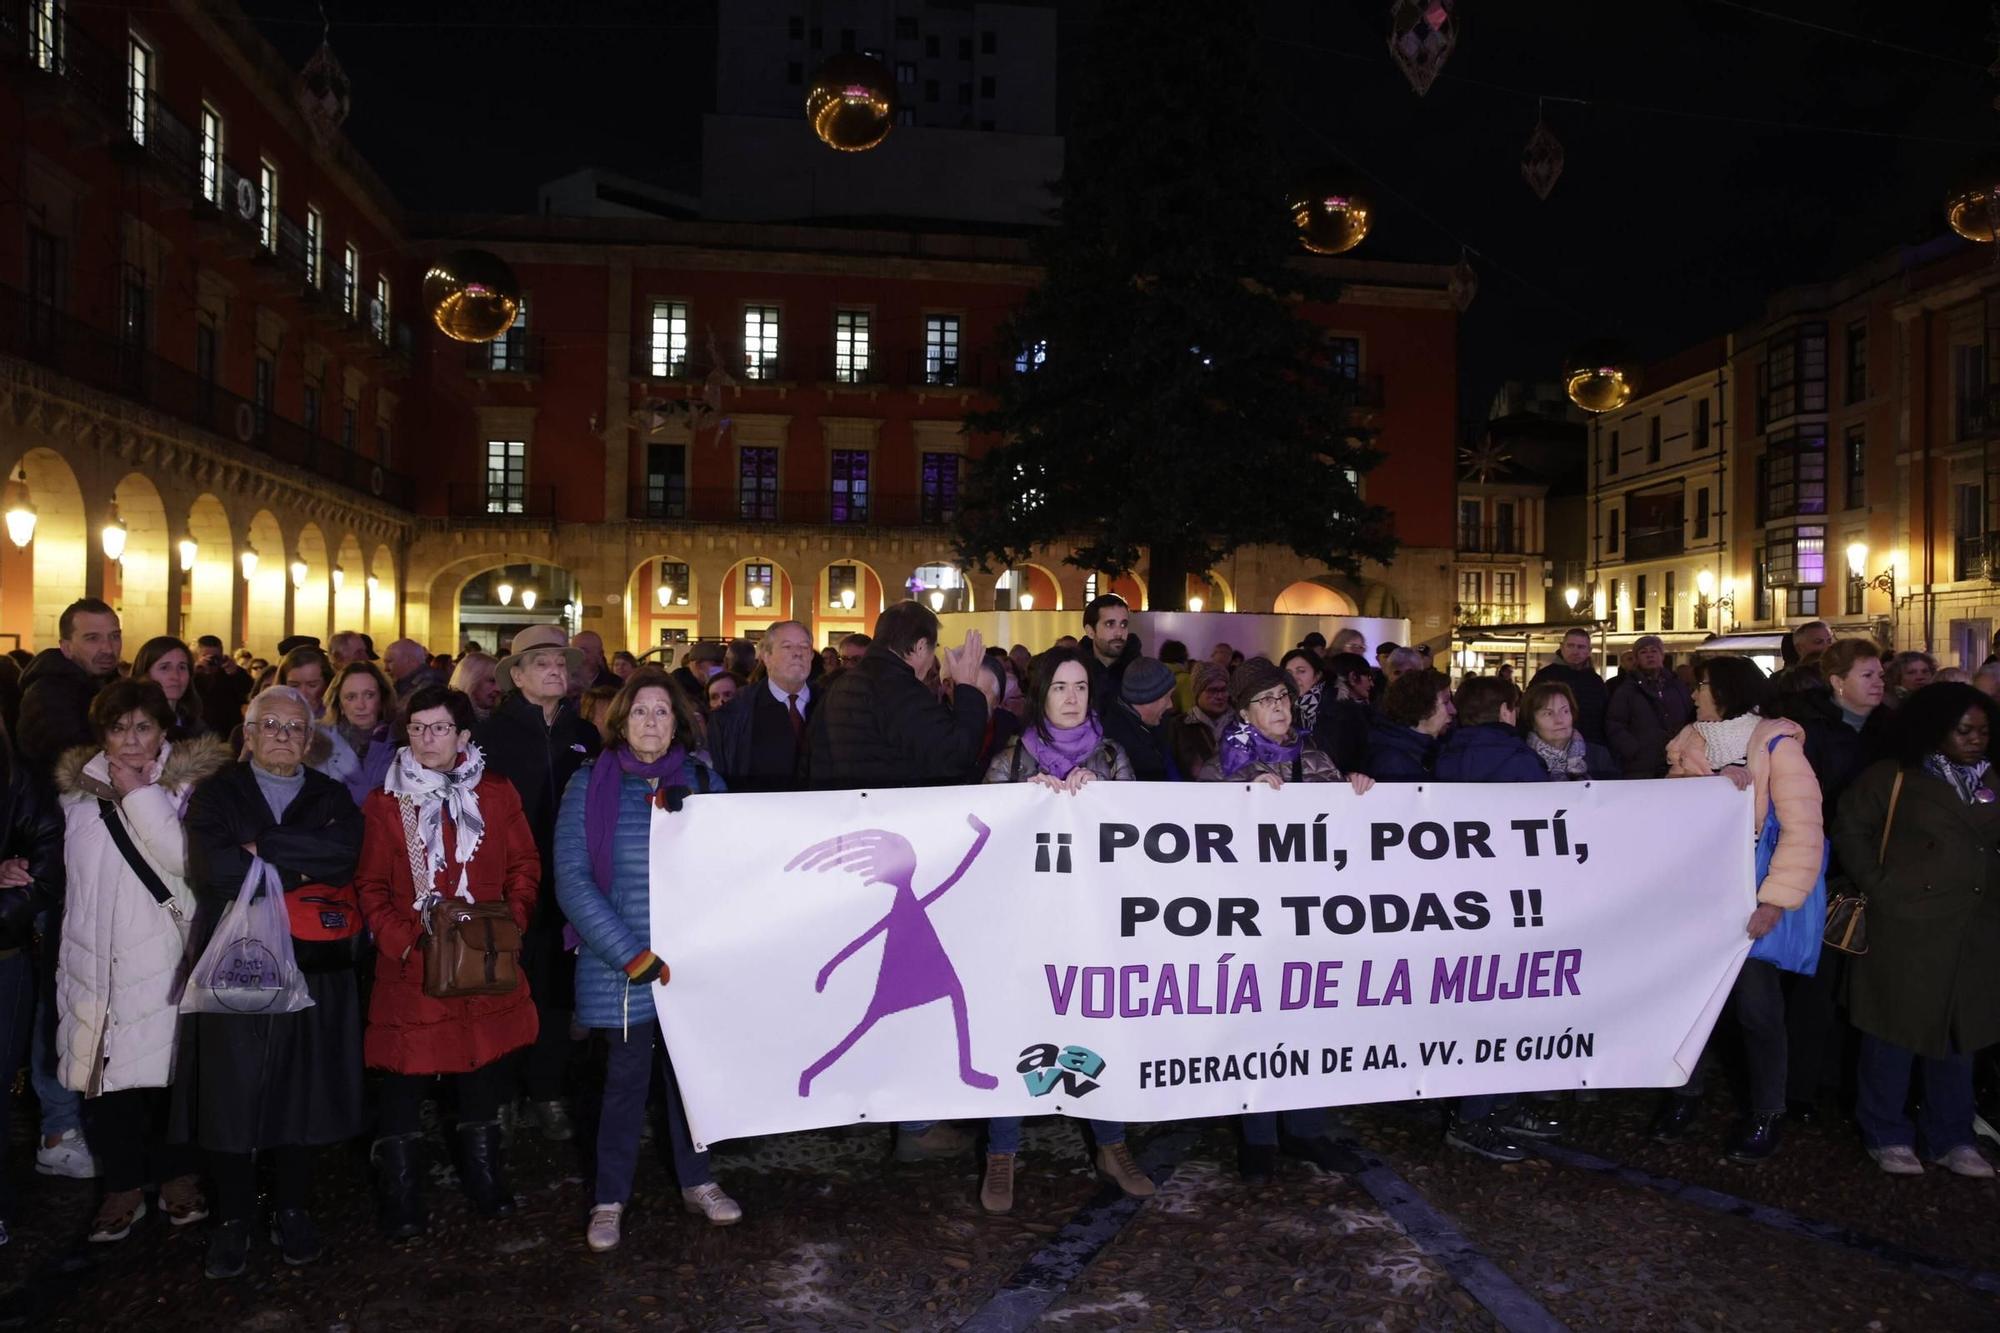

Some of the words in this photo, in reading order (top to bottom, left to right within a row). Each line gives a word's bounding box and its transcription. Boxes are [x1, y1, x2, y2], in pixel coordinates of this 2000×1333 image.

[1100, 823, 1238, 863] POR
[1258, 814, 1347, 871] MÍ,
[1371, 821, 1496, 860] POR
[1511, 810, 1588, 864] TÍ,
[1121, 897, 1261, 937] POR
[1281, 891, 1490, 936] TODAS
[1510, 889, 1543, 927] !!
[1045, 953, 1261, 1018] VOCALÍA
[1280, 961, 1343, 1010] DE
[1357, 959, 1412, 1006] LA
[1430, 949, 1582, 1004] MUJER
[1140, 1043, 1309, 1089] FEDERACIÓN
[1322, 1047, 1353, 1074] DE
[1363, 1044, 1407, 1070] AA.
[1419, 1041, 1463, 1066] VV.
[1475, 1038, 1507, 1063] DE
[1516, 1027, 1594, 1061] GIJÓN
